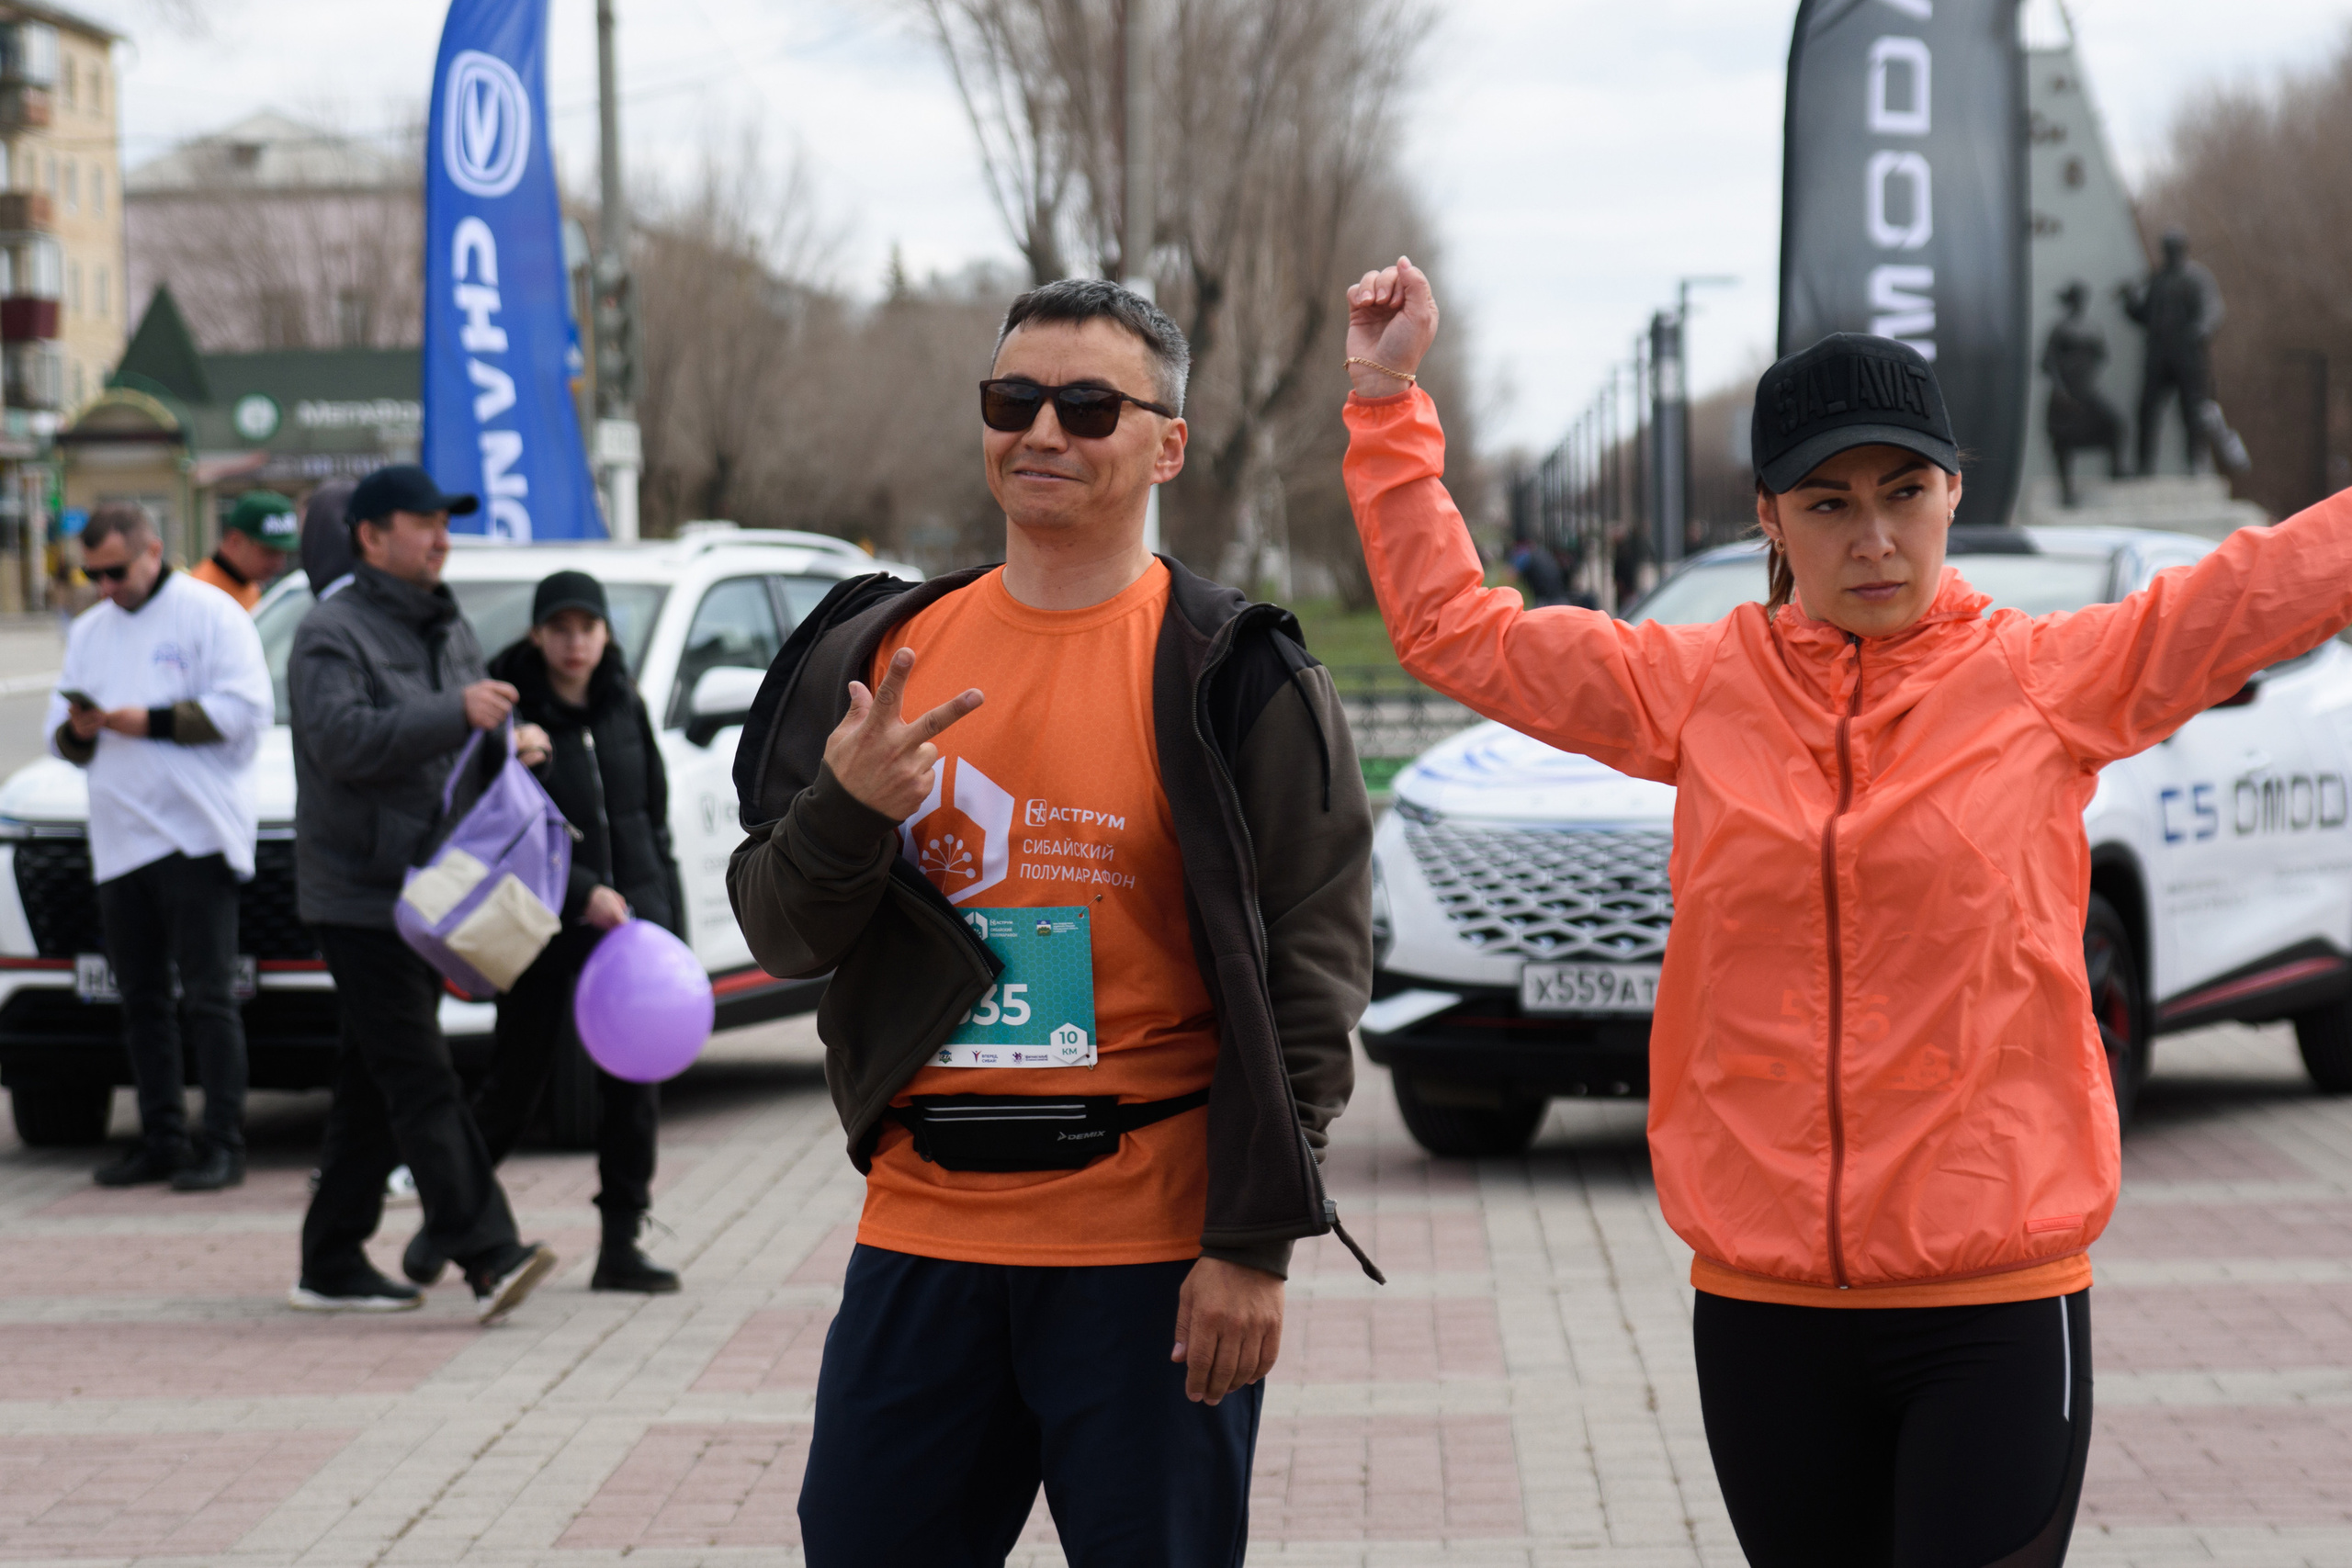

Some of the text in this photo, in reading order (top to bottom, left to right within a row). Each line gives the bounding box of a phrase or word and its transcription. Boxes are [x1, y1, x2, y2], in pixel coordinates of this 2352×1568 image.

[1868, 0, 1936, 364] MOD
[451, 215, 533, 543] CHANG
[1773, 352, 1929, 437] SALAVAT
[2233, 772, 2348, 835] OMOD
[1048, 807, 1125, 830] АСТРУМ
[1023, 837, 1114, 862] СИБАЙСКИЙ
[1020, 863, 1136, 889] ПОЛУМАРАФОН
[1059, 1031, 1079, 1045] 10
[1068, 1131, 1105, 1140] DEMIX
